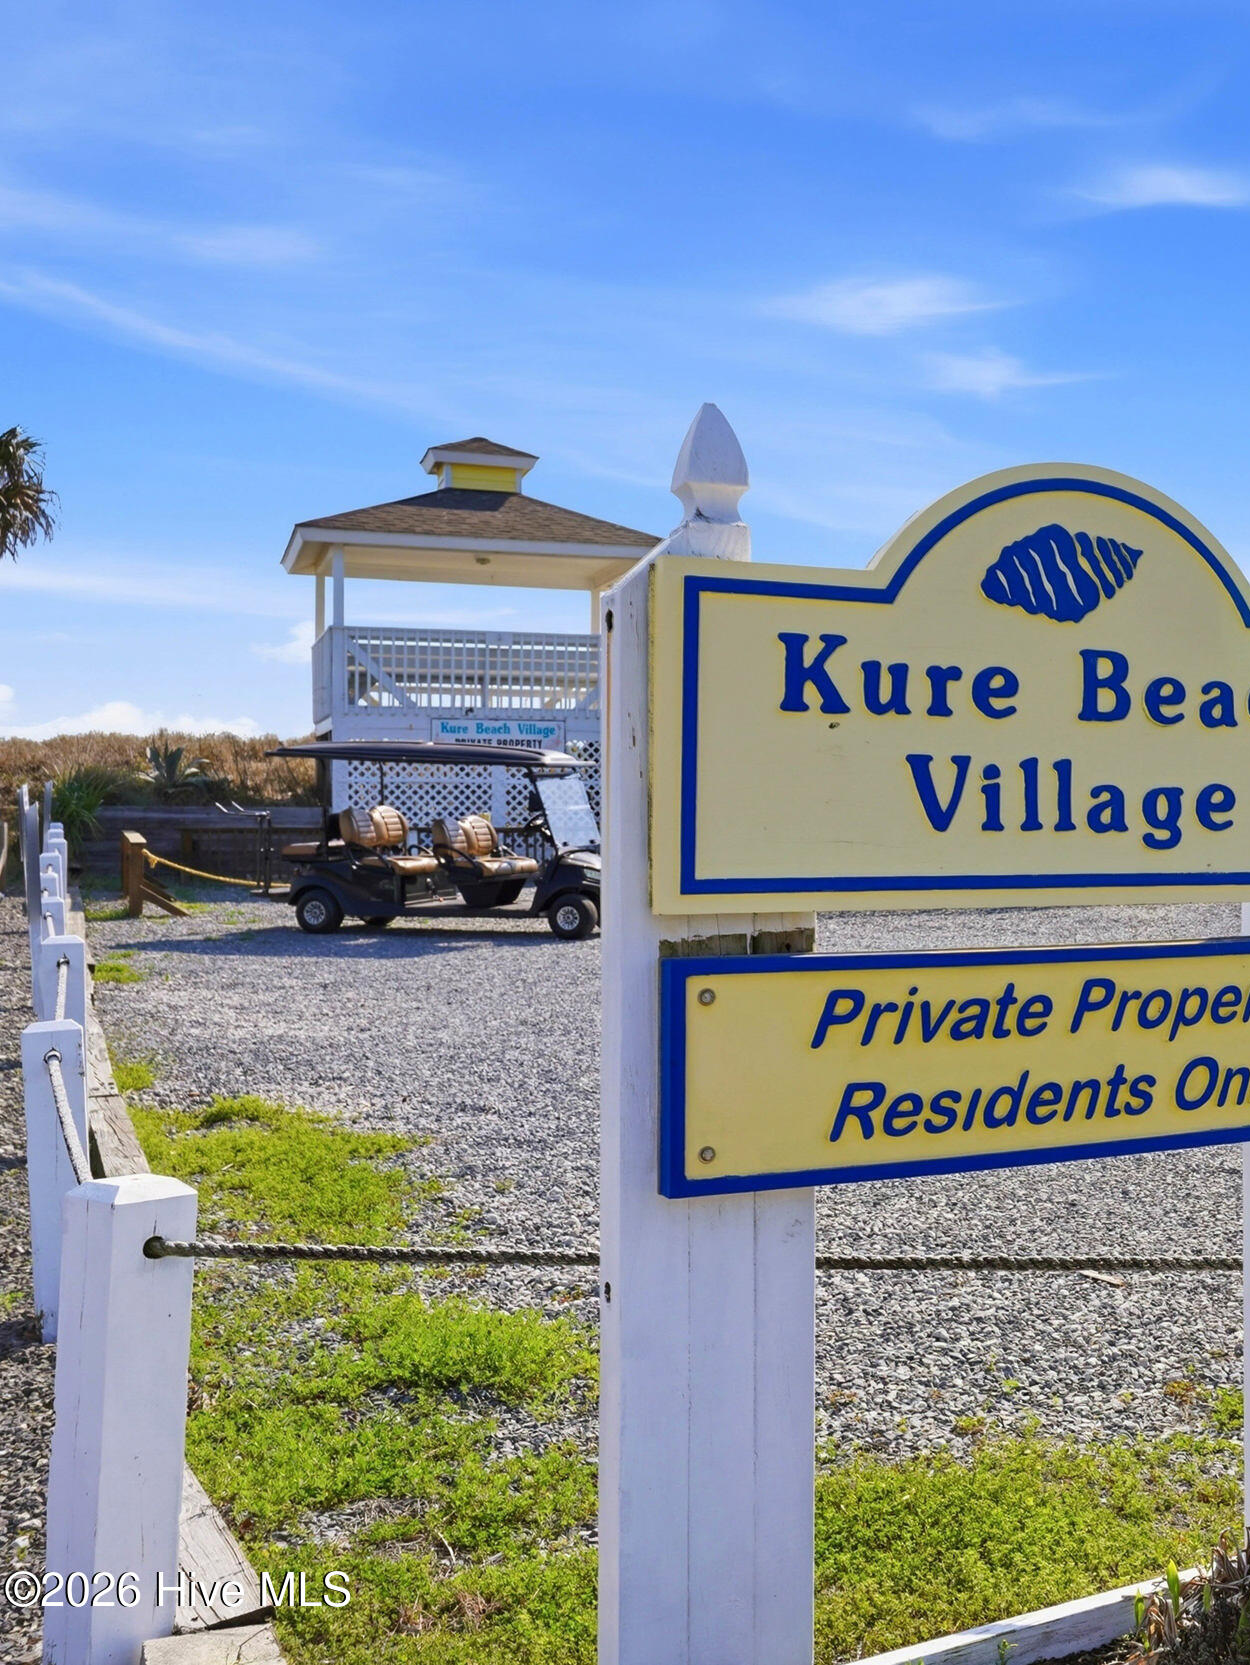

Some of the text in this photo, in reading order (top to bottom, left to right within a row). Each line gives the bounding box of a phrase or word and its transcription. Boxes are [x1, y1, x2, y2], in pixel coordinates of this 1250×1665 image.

[777, 632, 1019, 719] Kure
[441, 721, 556, 738] Kure Beach Village
[905, 753, 1236, 850] Village
[810, 982, 1054, 1049] Private
[829, 1064, 1156, 1143] Residents
